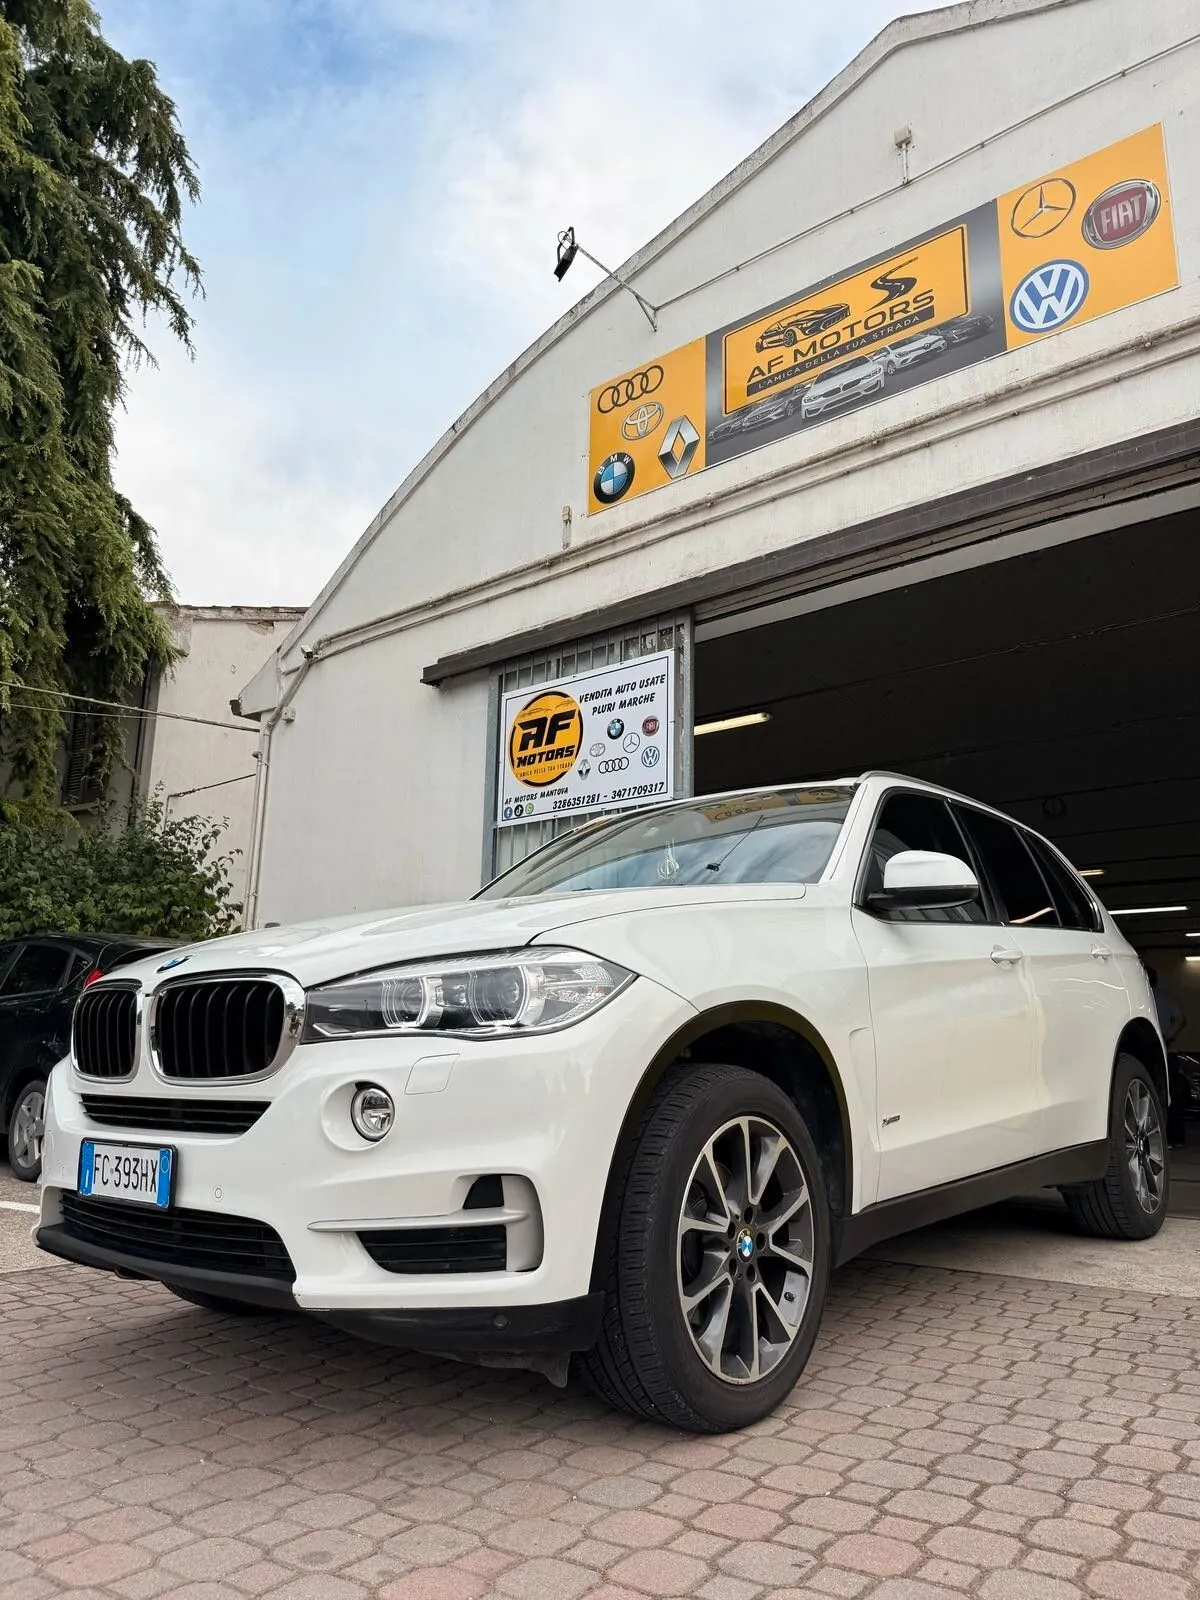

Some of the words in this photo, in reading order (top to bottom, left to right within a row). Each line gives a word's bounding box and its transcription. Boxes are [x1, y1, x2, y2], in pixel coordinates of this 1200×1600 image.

[1100, 194, 1143, 235] FIAT
[747, 355, 784, 383] AF
[793, 288, 935, 363] MOTORS
[758, 366, 801, 390] L'AMICA
[805, 349, 840, 370] DELLA
[846, 338, 867, 352] TUA
[872, 315, 920, 340] STRADA
[598, 453, 632, 475] BMW
[579, 687, 612, 704] VENDITA
[615, 681, 636, 695] AUTO
[639, 674, 666, 689] USATE
[592, 702, 616, 716] PLURI
[618, 692, 656, 710] MARCHE
[518, 709, 577, 752] AF
[516, 745, 575, 768] MOTORS
[504, 797, 512, 805] AF
[514, 792, 538, 803] MOTORS
[540, 787, 569, 798] MANTOVA
[552, 793, 601, 810] 3286351281
[612, 781, 665, 801] 3471709317
